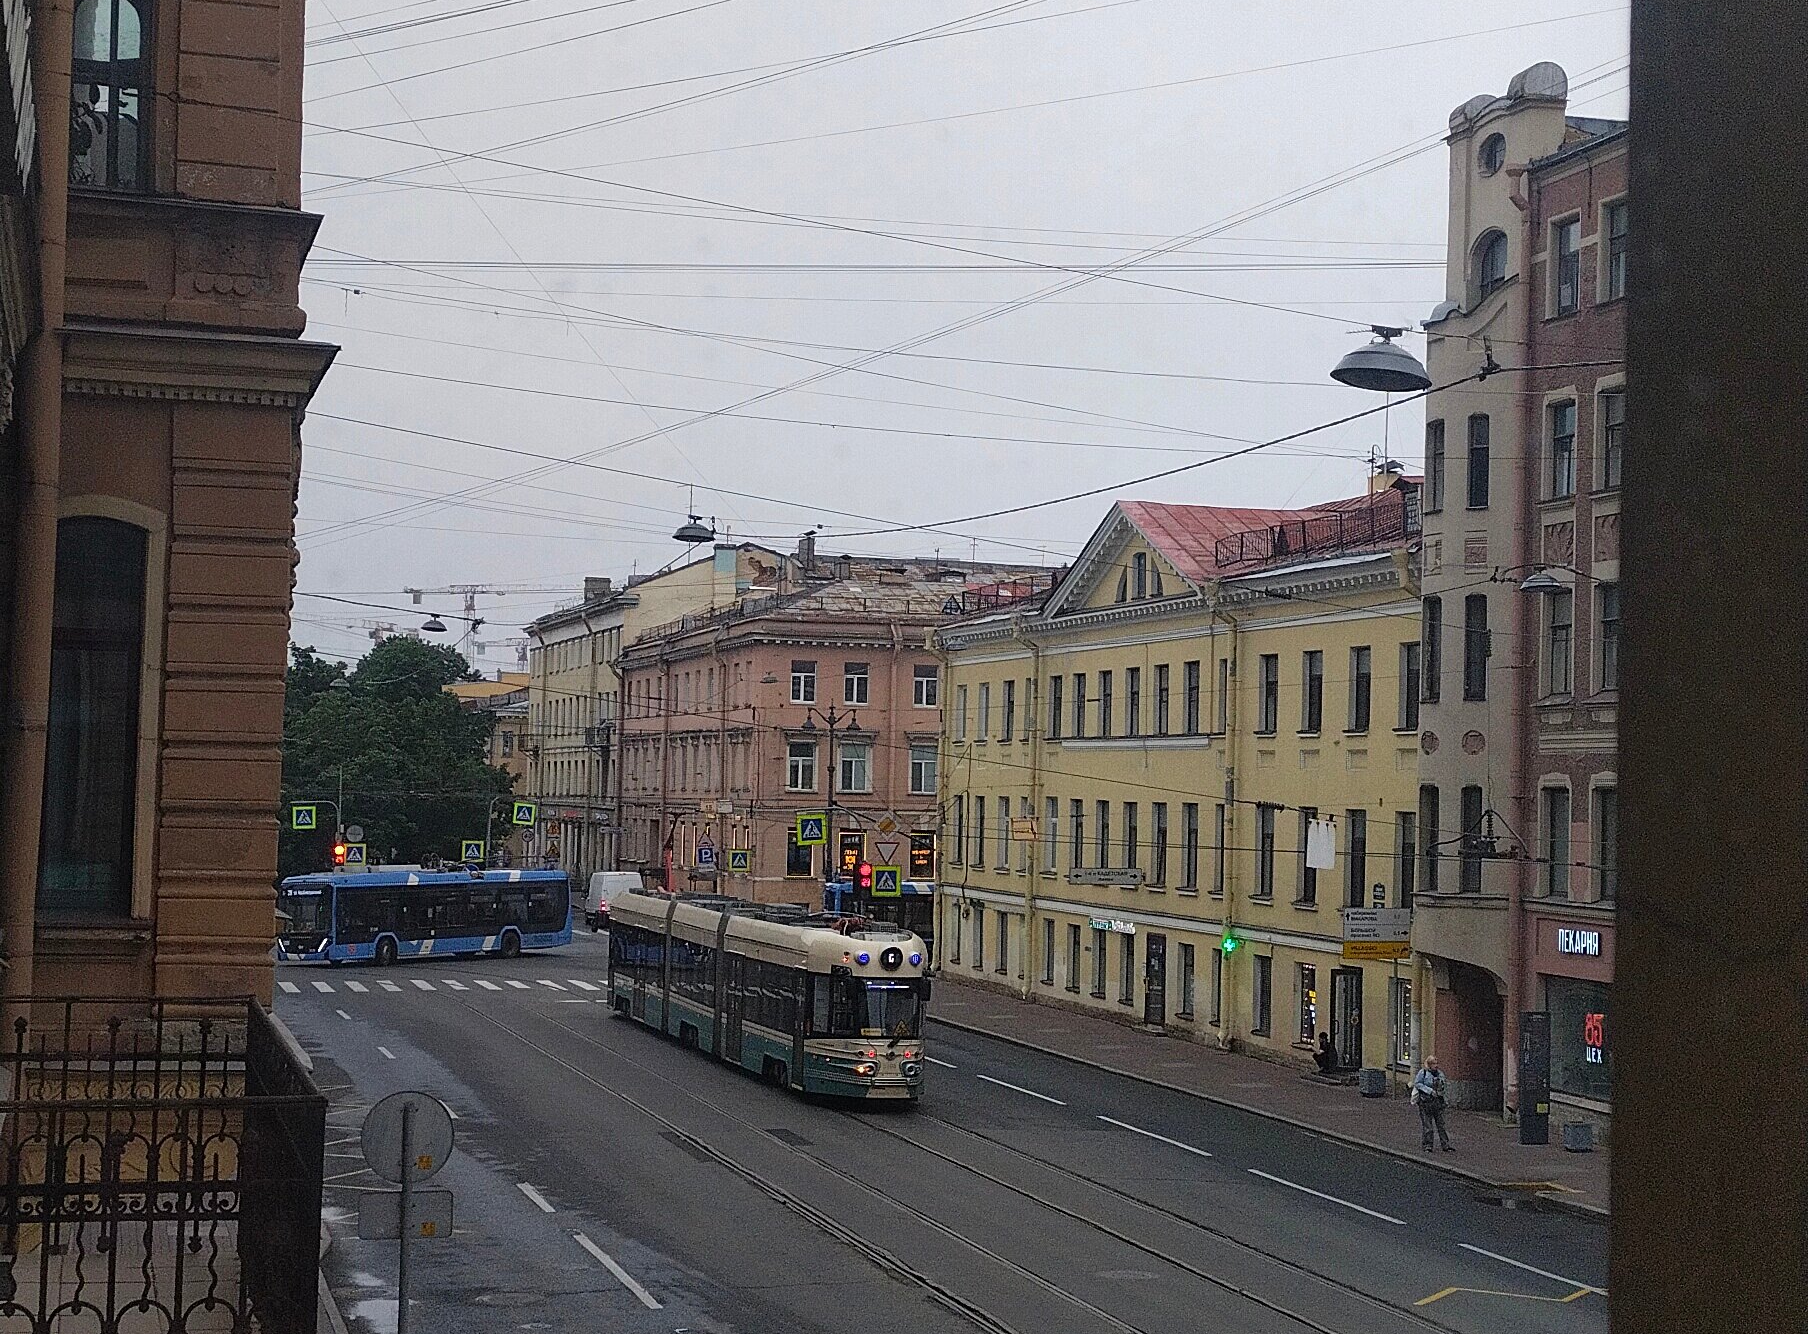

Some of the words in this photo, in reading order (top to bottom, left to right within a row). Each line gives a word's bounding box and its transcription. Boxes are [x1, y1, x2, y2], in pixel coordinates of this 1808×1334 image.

[1558, 928, 1599, 956] ПЕКАРНЯ
[1584, 1013, 1604, 1048] 85
[1586, 1046, 1603, 1064] ЦЕХ
